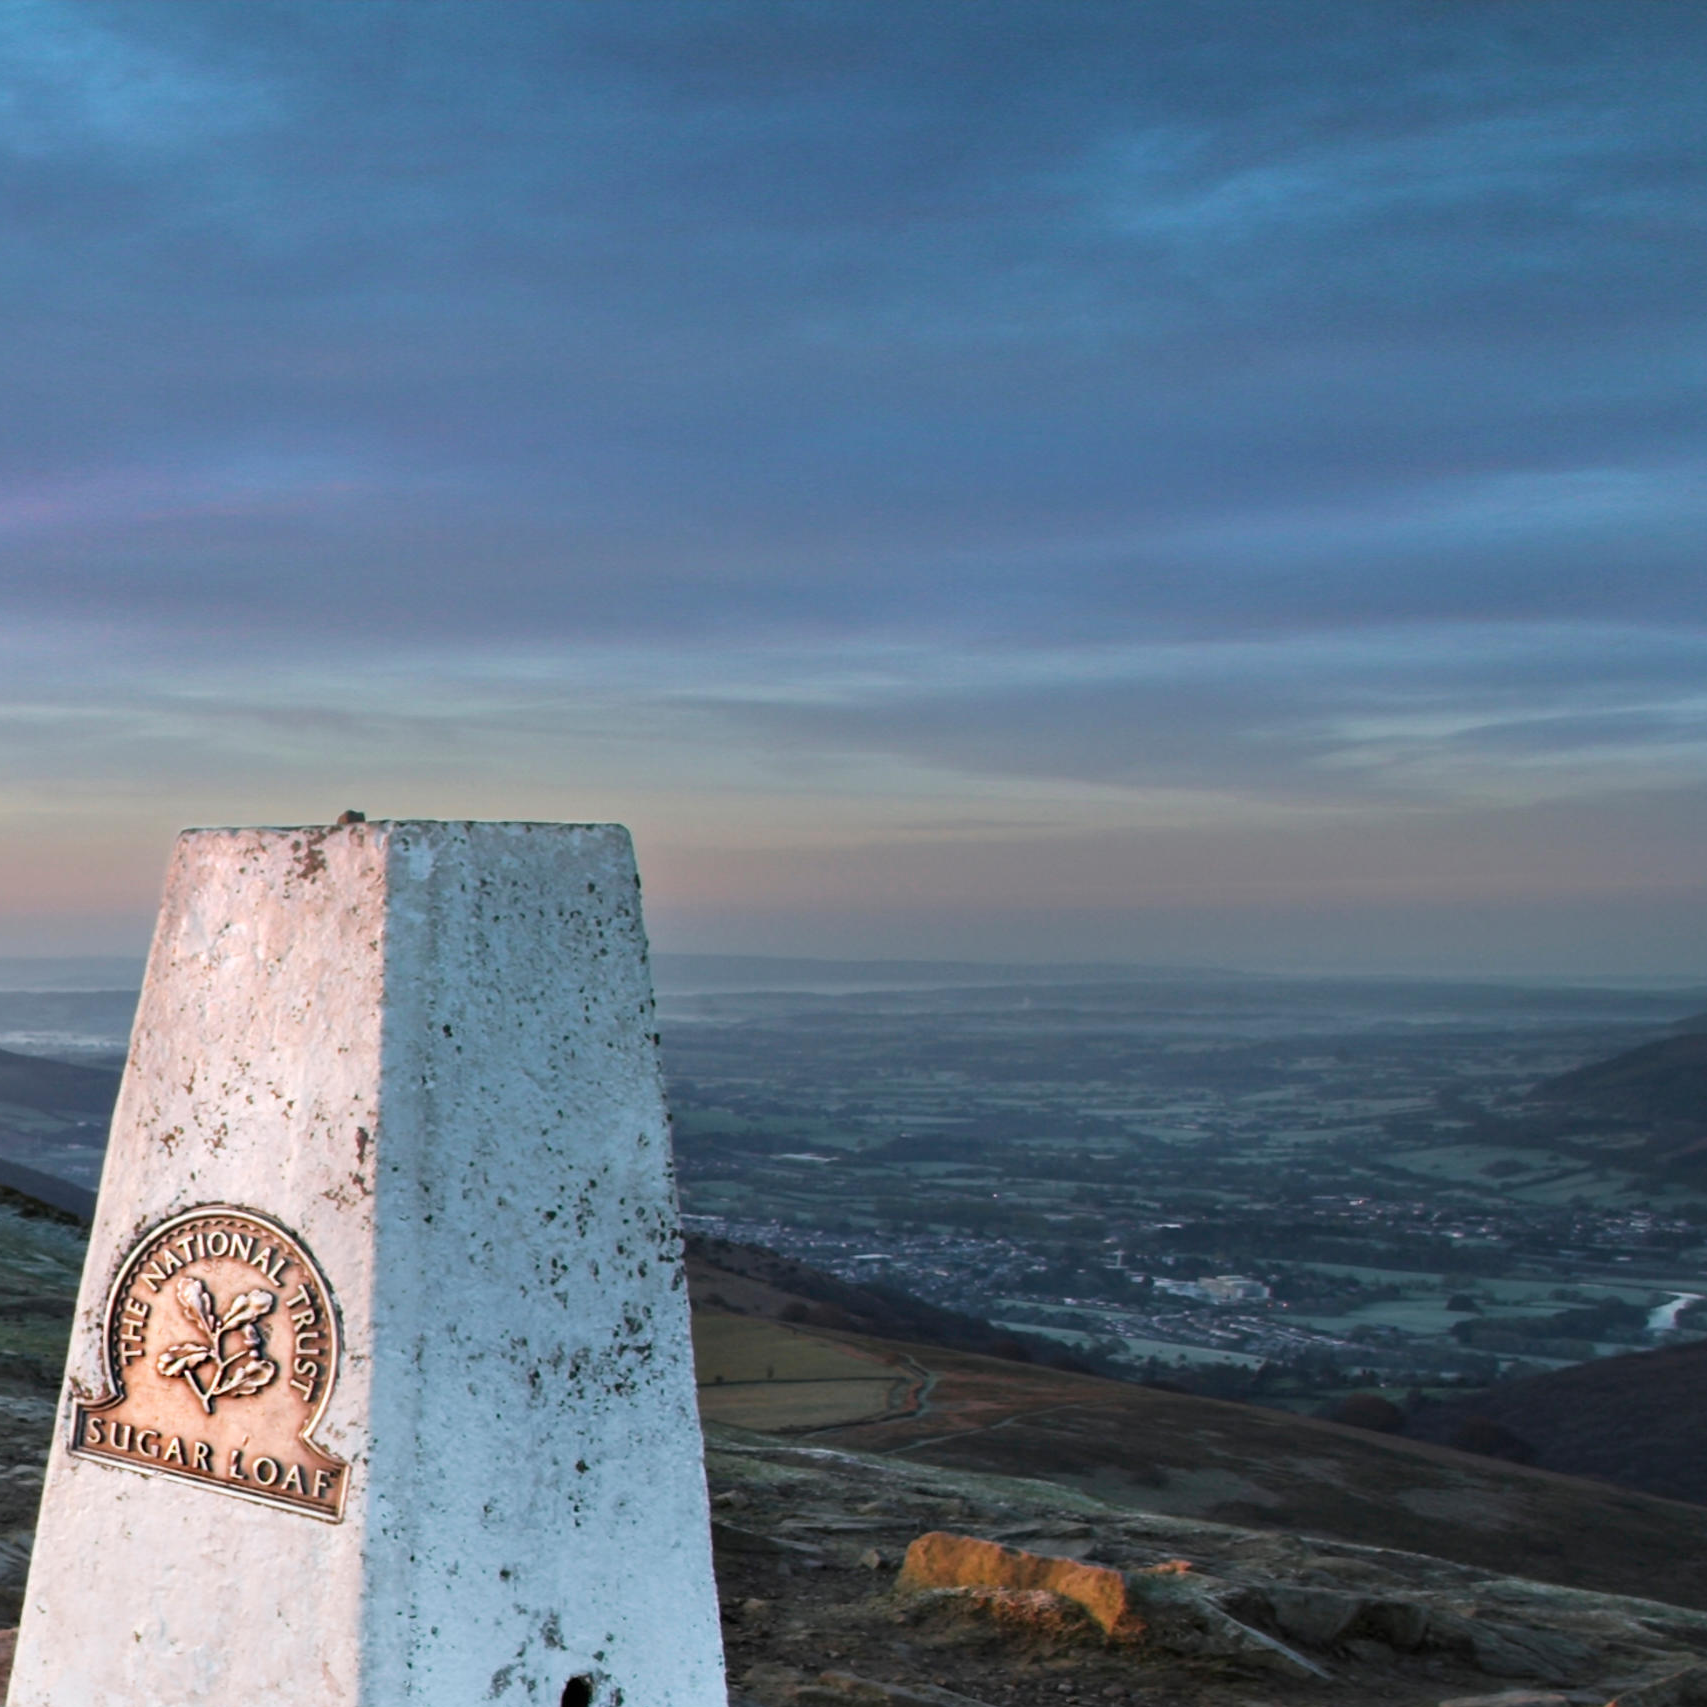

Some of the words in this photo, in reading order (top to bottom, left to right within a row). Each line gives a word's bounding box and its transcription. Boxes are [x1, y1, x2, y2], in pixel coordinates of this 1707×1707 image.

[122, 1297, 150, 1364] THE
[144, 1231, 288, 1292] NATIONAL
[286, 1284, 319, 1402] TRUST
[87, 1418, 211, 1471] SUGAR
[229, 1450, 334, 1498] LOAF
